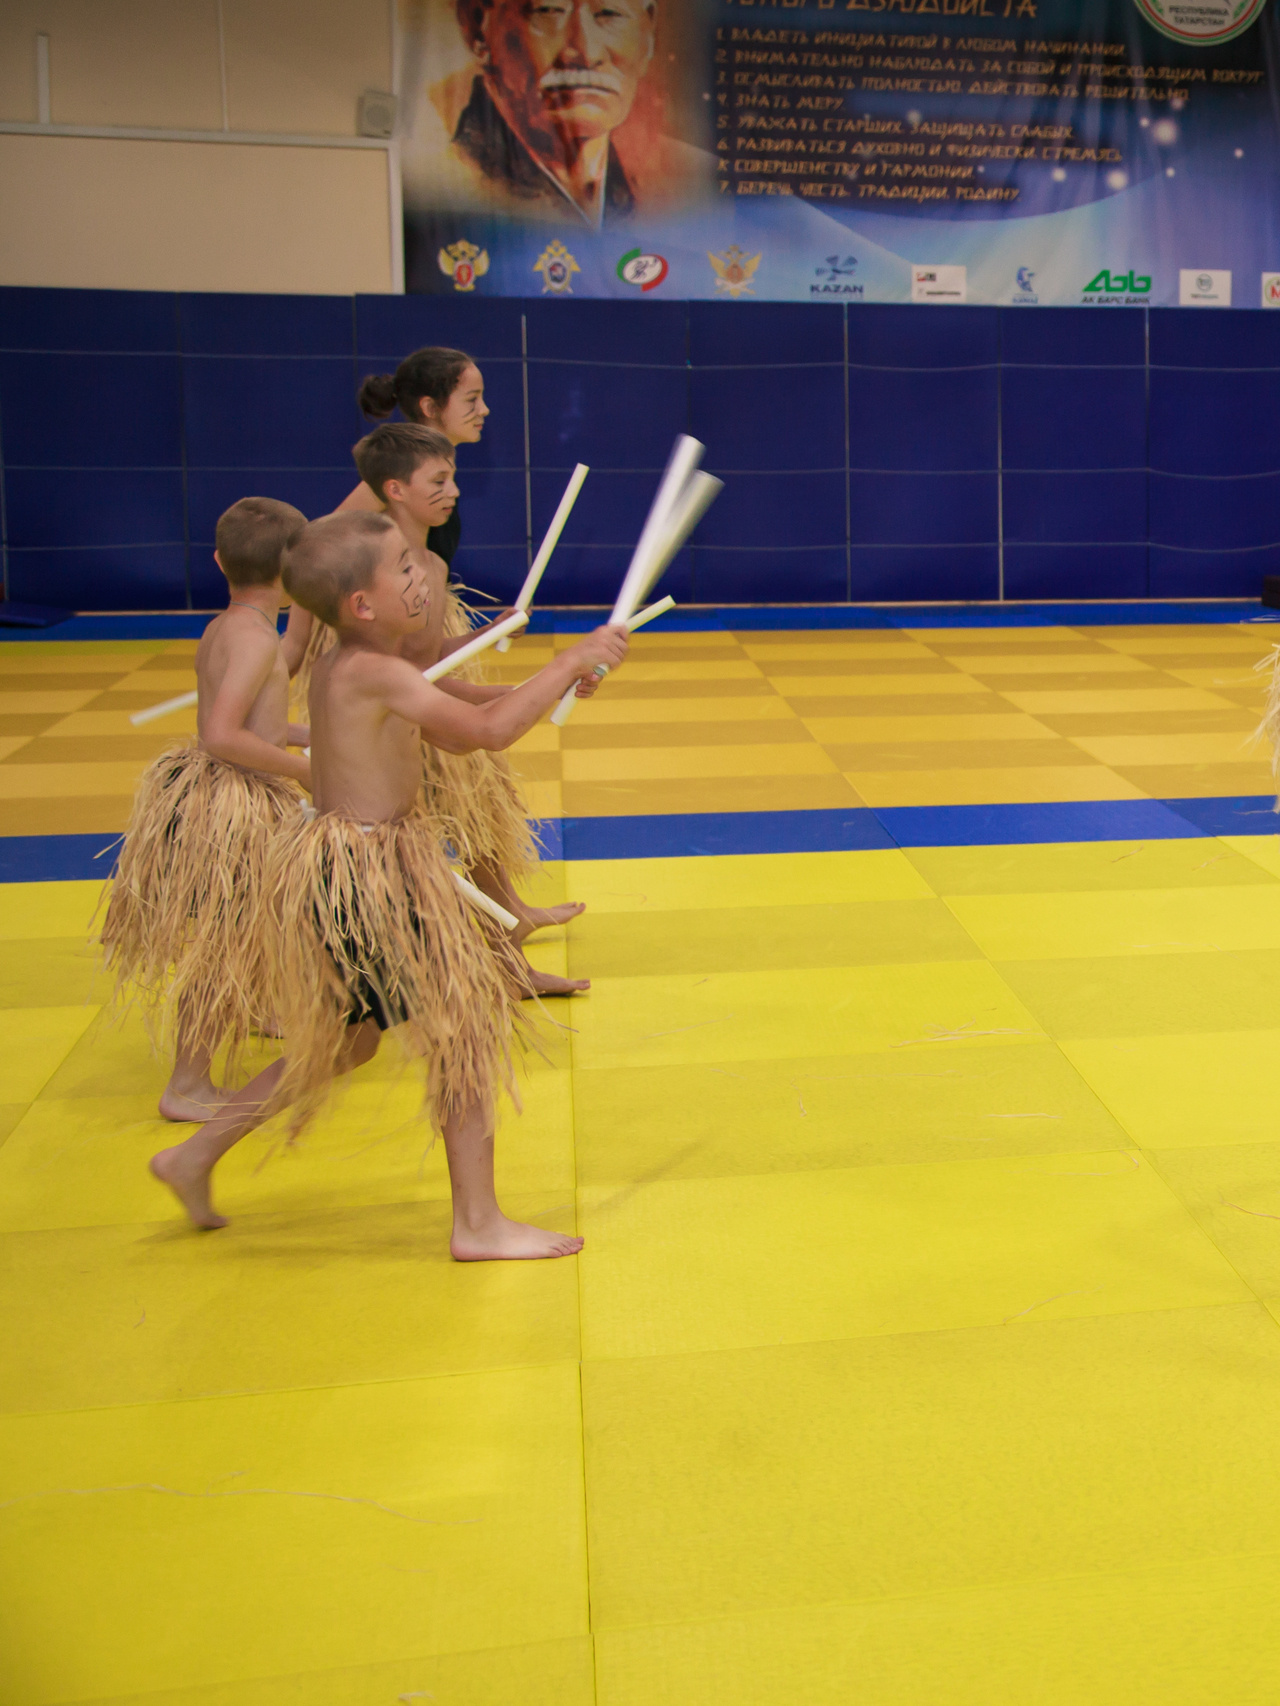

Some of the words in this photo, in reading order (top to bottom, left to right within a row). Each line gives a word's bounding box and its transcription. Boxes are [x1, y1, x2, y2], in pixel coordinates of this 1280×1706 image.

[1168, 5, 1229, 15] РЕСПУБЛИКА
[1174, 15, 1225, 26] ТАТАРСТАН
[731, 27, 809, 44] ВЛАДЕТЬ
[814, 31, 938, 51] ИНИЦИАТИВОЙ
[943, 36, 951, 49] В
[956, 37, 1017, 52] ЛЮБОМ
[734, 50, 864, 68] ВНИМАТЕЛЬНО
[869, 56, 975, 73] НАБЛЮДАТЬ
[980, 60, 1002, 73] ЗА
[1007, 59, 1056, 75] СОБОЙ
[1060, 64, 1072, 75] И
[1078, 63, 1206, 84] ПРОИСХОДЯЩИМ
[733, 72, 855, 89] ОСМЫСЛИВАТЬ
[968, 79, 1079, 97] ДЕЙСТВОВАТЬ
[735, 93, 791, 108] ЗНАТЬ
[738, 115, 818, 131] УВАЖАТЬ
[910, 121, 1005, 141] ЗАЩИЩАТЬ
[736, 137, 847, 153] РАЗВИВАТЬСЯ
[851, 141, 925, 157] ДУХОВНО
[928, 144, 942, 157] И
[1042, 147, 1122, 161] СТРЕМЯСЬ
[734, 158, 860, 176] СОВЕРШЕНСТВУ
[864, 163, 877, 176] И
[737, 180, 794, 195] БЕРЕЧЬ
[810, 284, 864, 294] KAZAN
[1097, 296, 1123, 304] БАРС
[1125, 296, 1150, 304] БАНК
